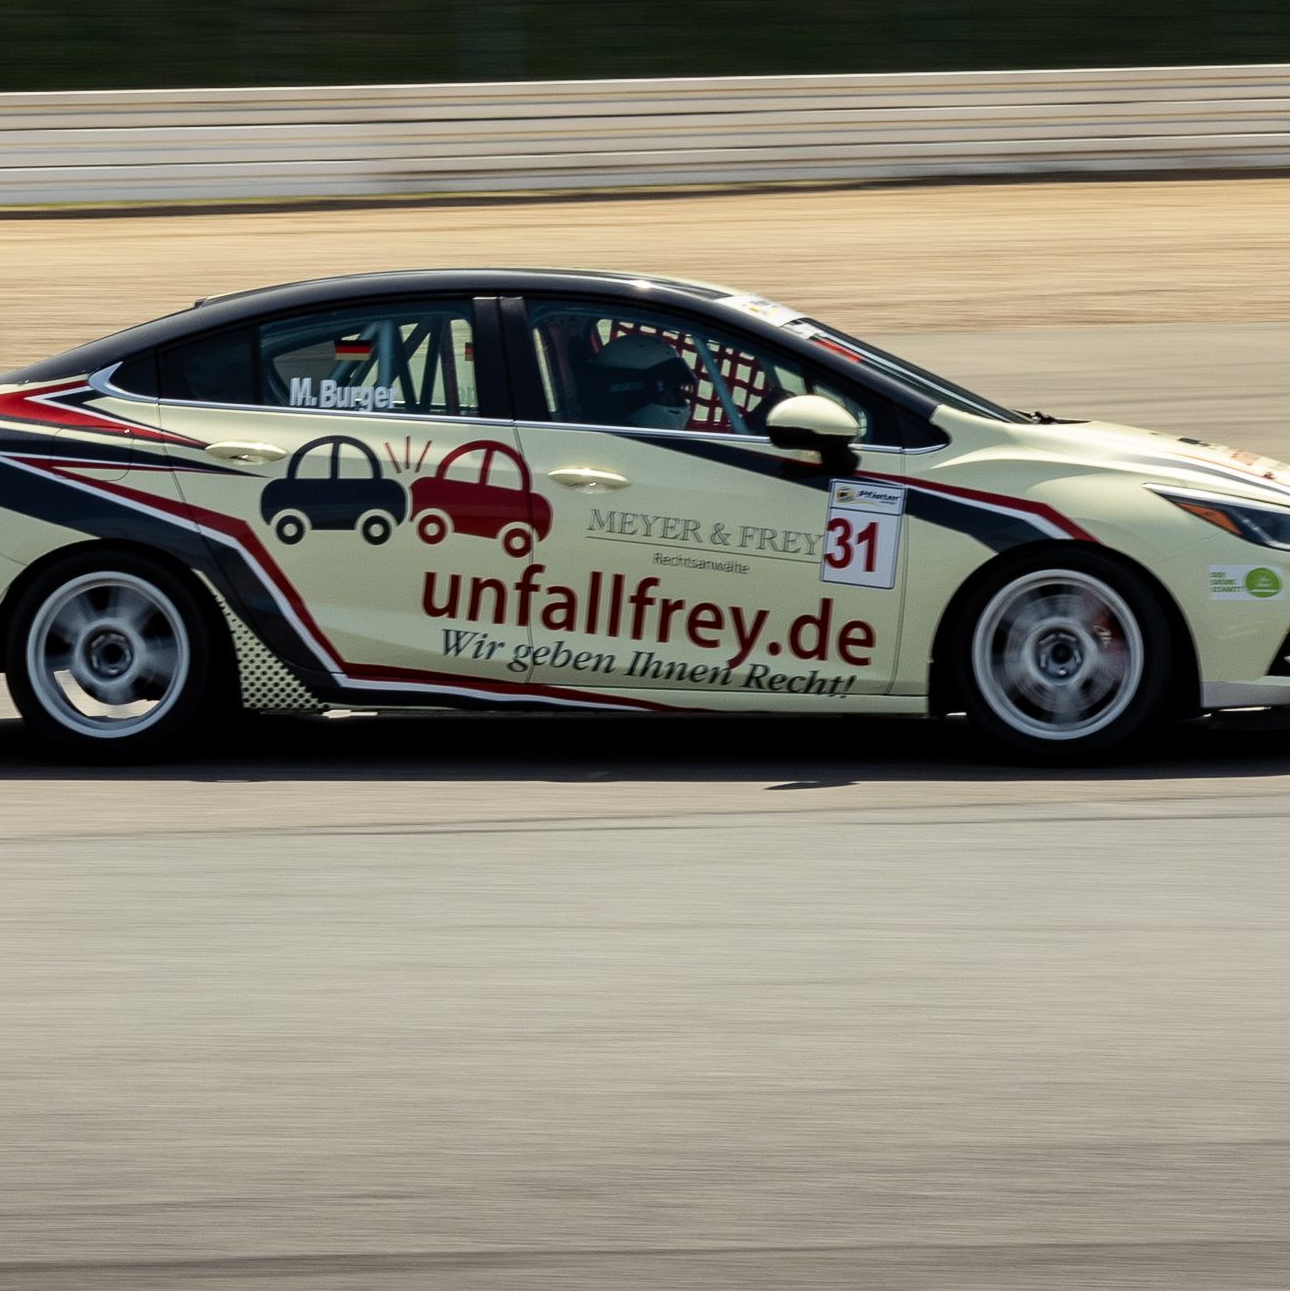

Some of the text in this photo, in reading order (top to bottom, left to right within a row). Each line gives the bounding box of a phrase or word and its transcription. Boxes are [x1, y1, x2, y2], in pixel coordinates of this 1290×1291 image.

[586, 508, 825, 556] MEYER & FREY
[824, 517, 879, 573] 31
[421, 563, 877, 669] unfallfrey.de
[441, 628, 857, 699] Wir geben Ihnen Recht!
